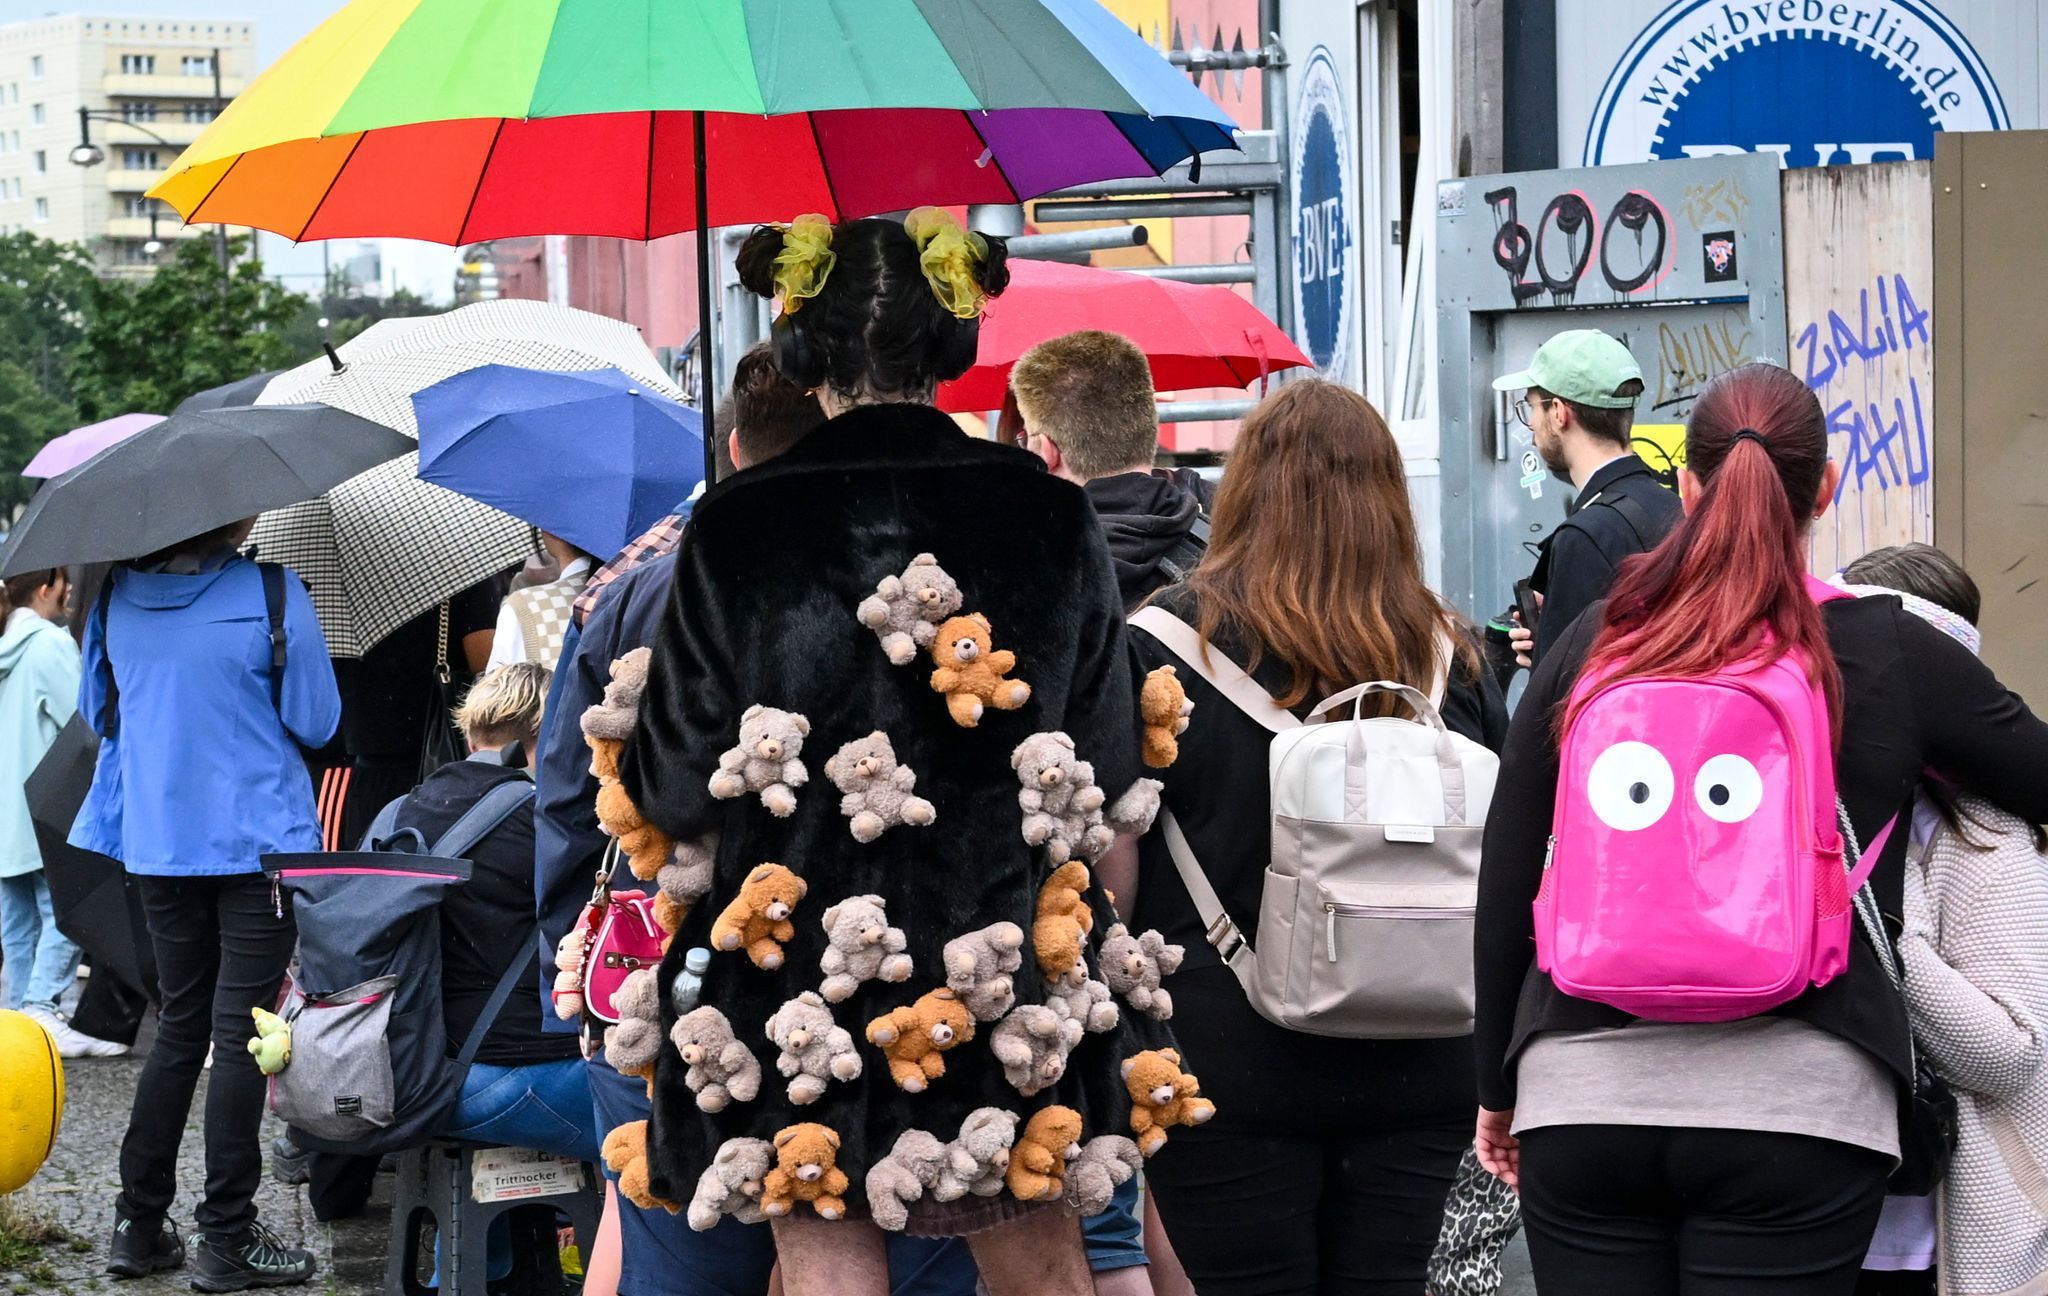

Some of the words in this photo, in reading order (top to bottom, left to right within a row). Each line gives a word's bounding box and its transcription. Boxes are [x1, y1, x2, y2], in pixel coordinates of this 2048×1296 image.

[1640, 0, 1962, 113] www.bveberlin.de
[1302, 196, 1341, 284] BVE
[494, 1170, 558, 1186] Tritthocker
